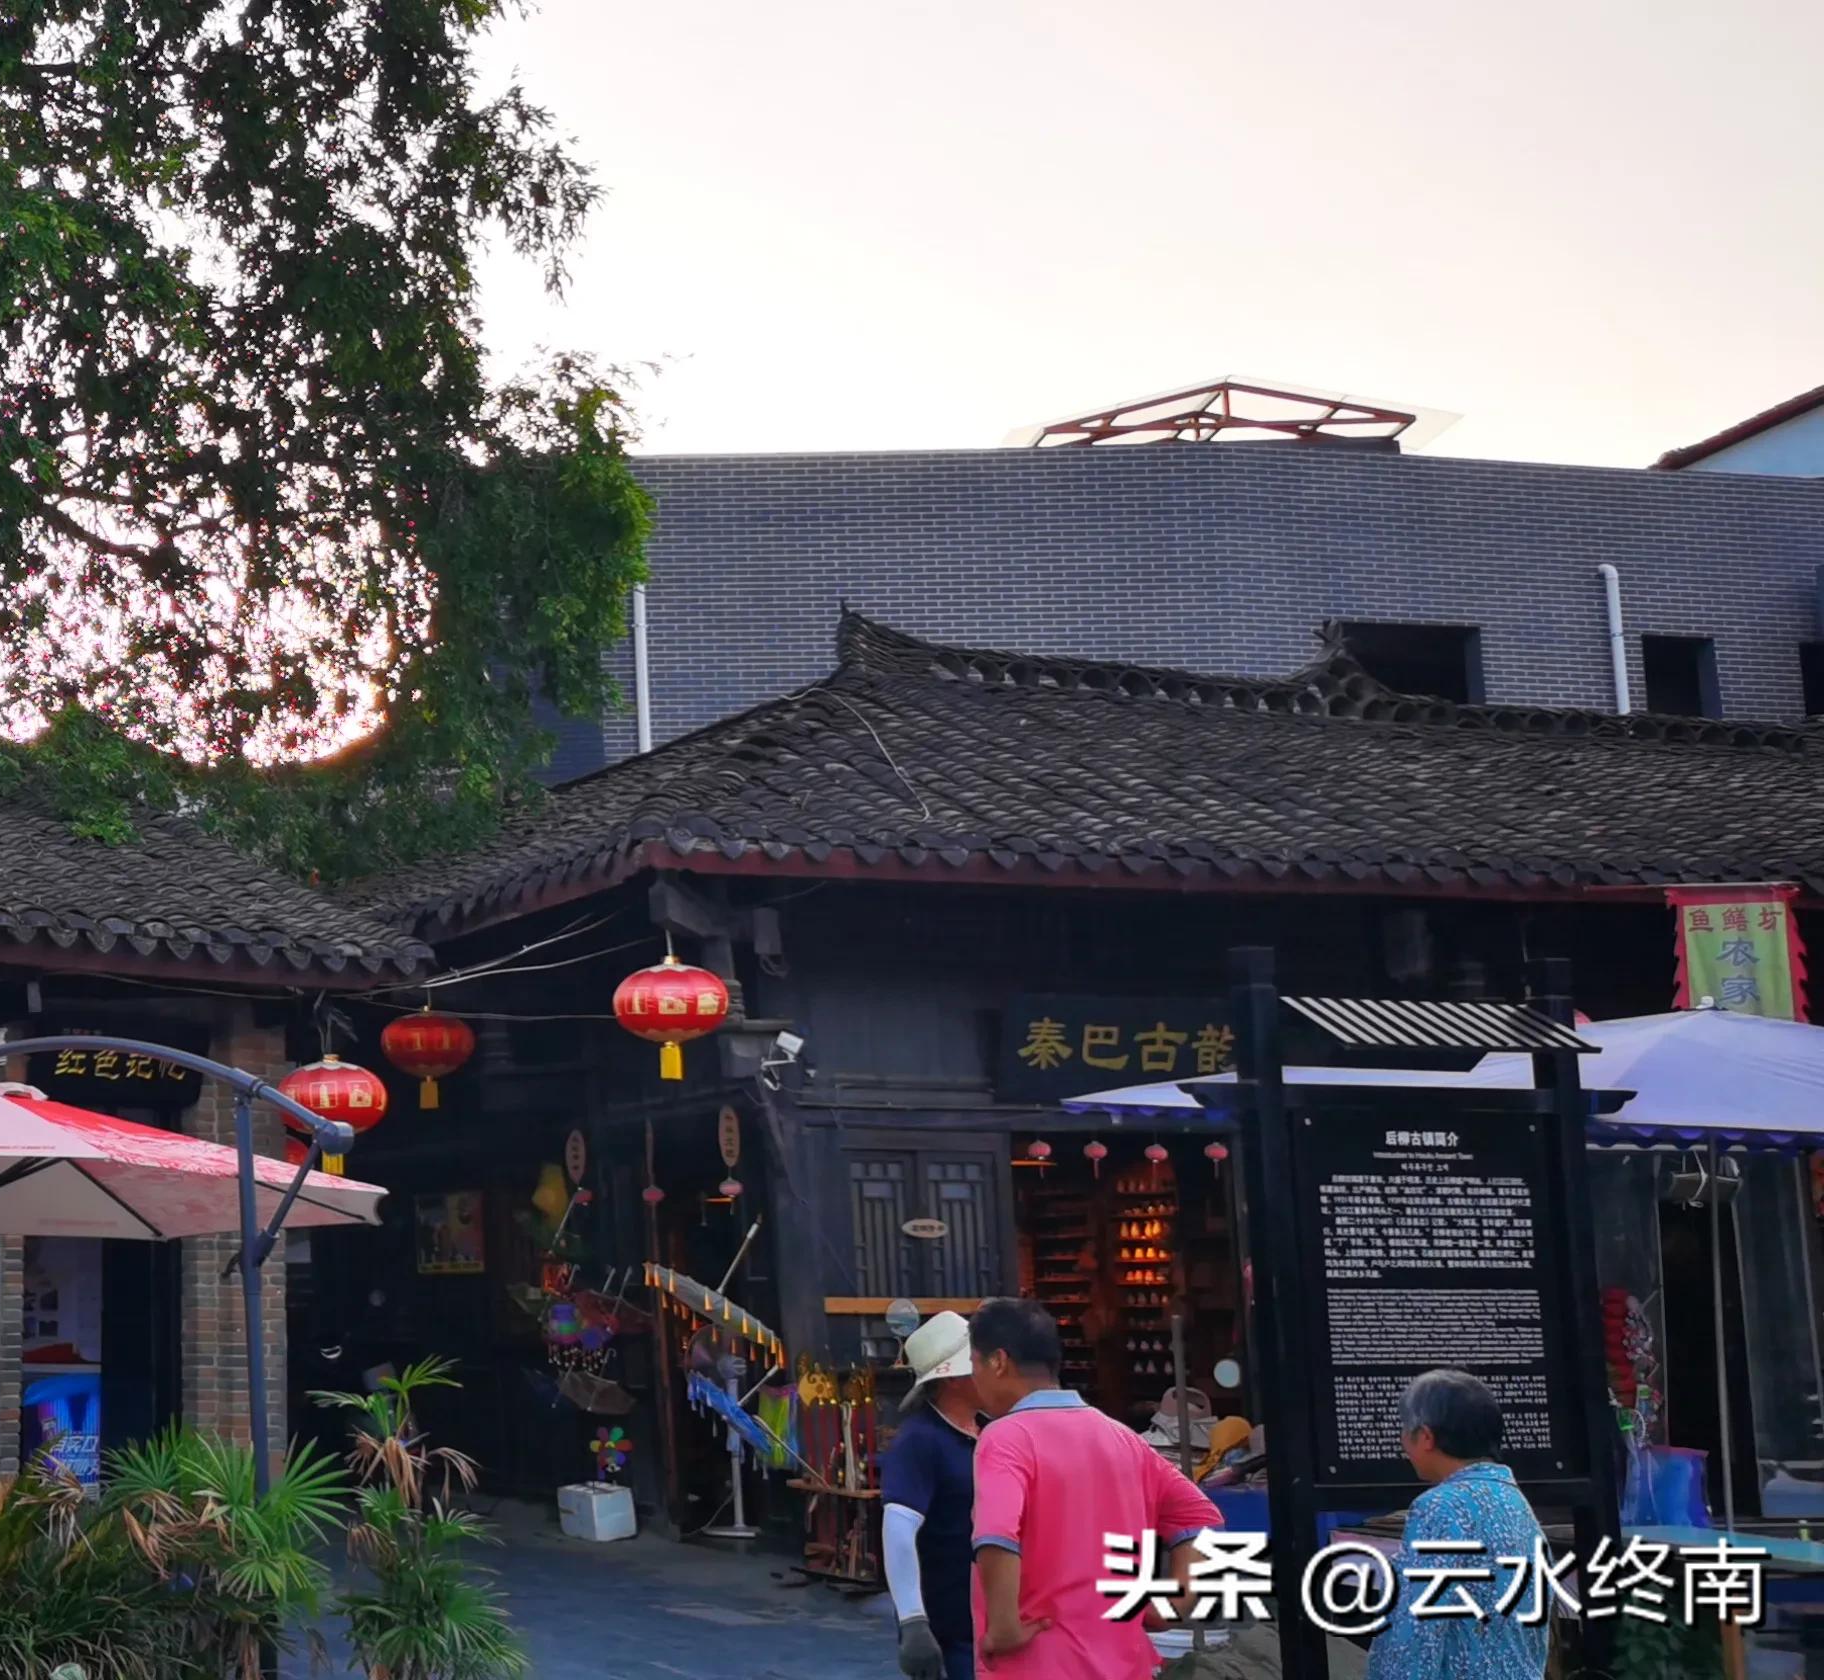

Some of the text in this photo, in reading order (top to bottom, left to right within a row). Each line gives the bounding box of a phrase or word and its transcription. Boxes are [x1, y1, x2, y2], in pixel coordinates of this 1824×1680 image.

[1715, 936, 1763, 1005] 农家
[54, 1048, 185, 1080] 红色记忆
